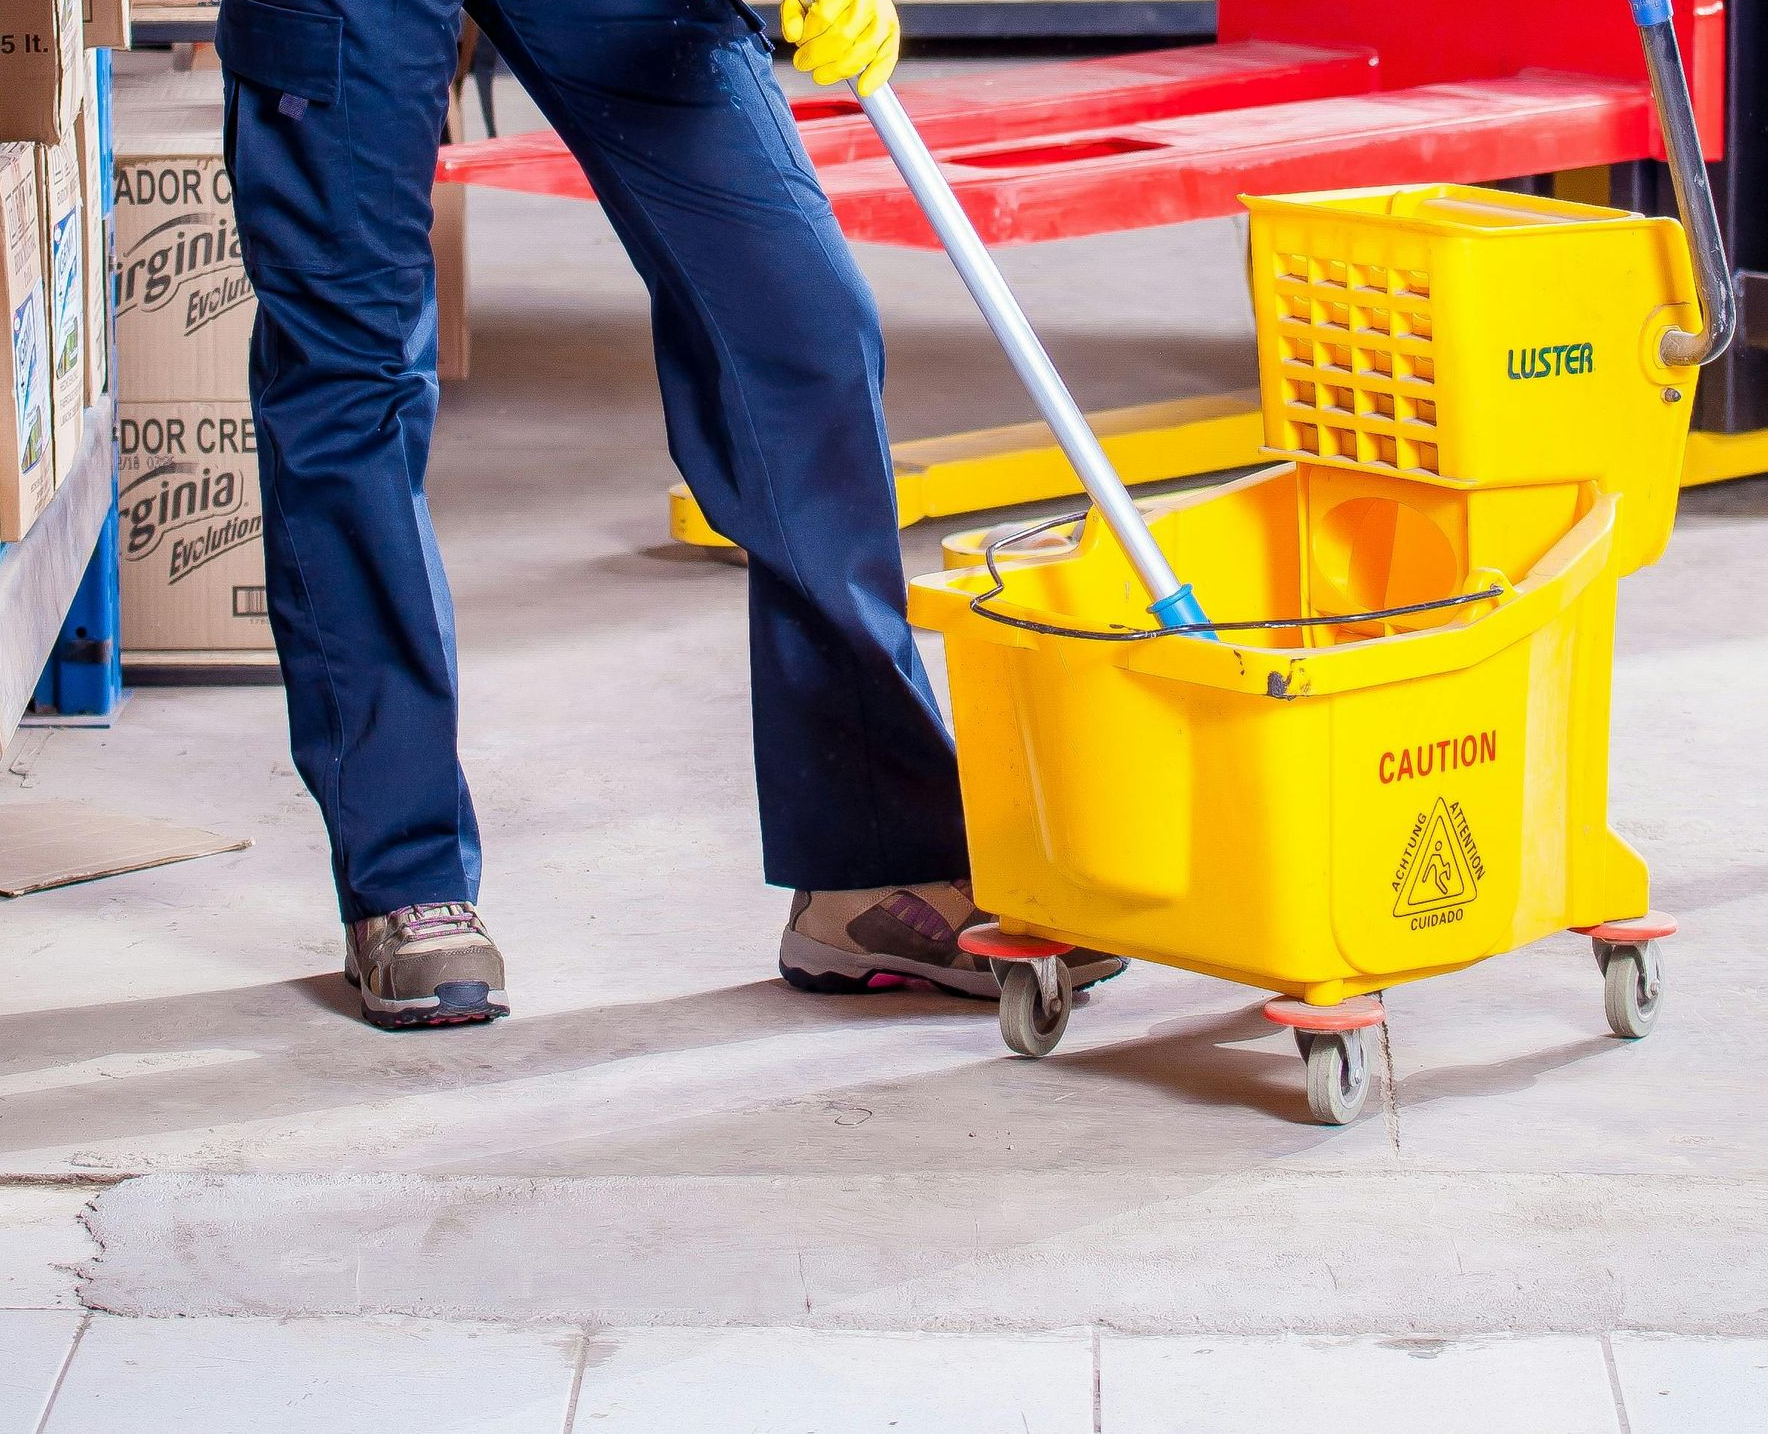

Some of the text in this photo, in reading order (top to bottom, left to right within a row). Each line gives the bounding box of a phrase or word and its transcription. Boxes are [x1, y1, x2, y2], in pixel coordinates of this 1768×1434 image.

[1, 34, 15, 54] 5
[1507, 342, 1594, 380] LUSTER
[169, 515, 262, 578] Evolution
[1379, 730, 1497, 785] CAUTION
[1391, 812, 1428, 893] ACHTUNG
[1449, 801, 1485, 881] ATTENTION
[1410, 908, 1464, 931] CUIDADO
